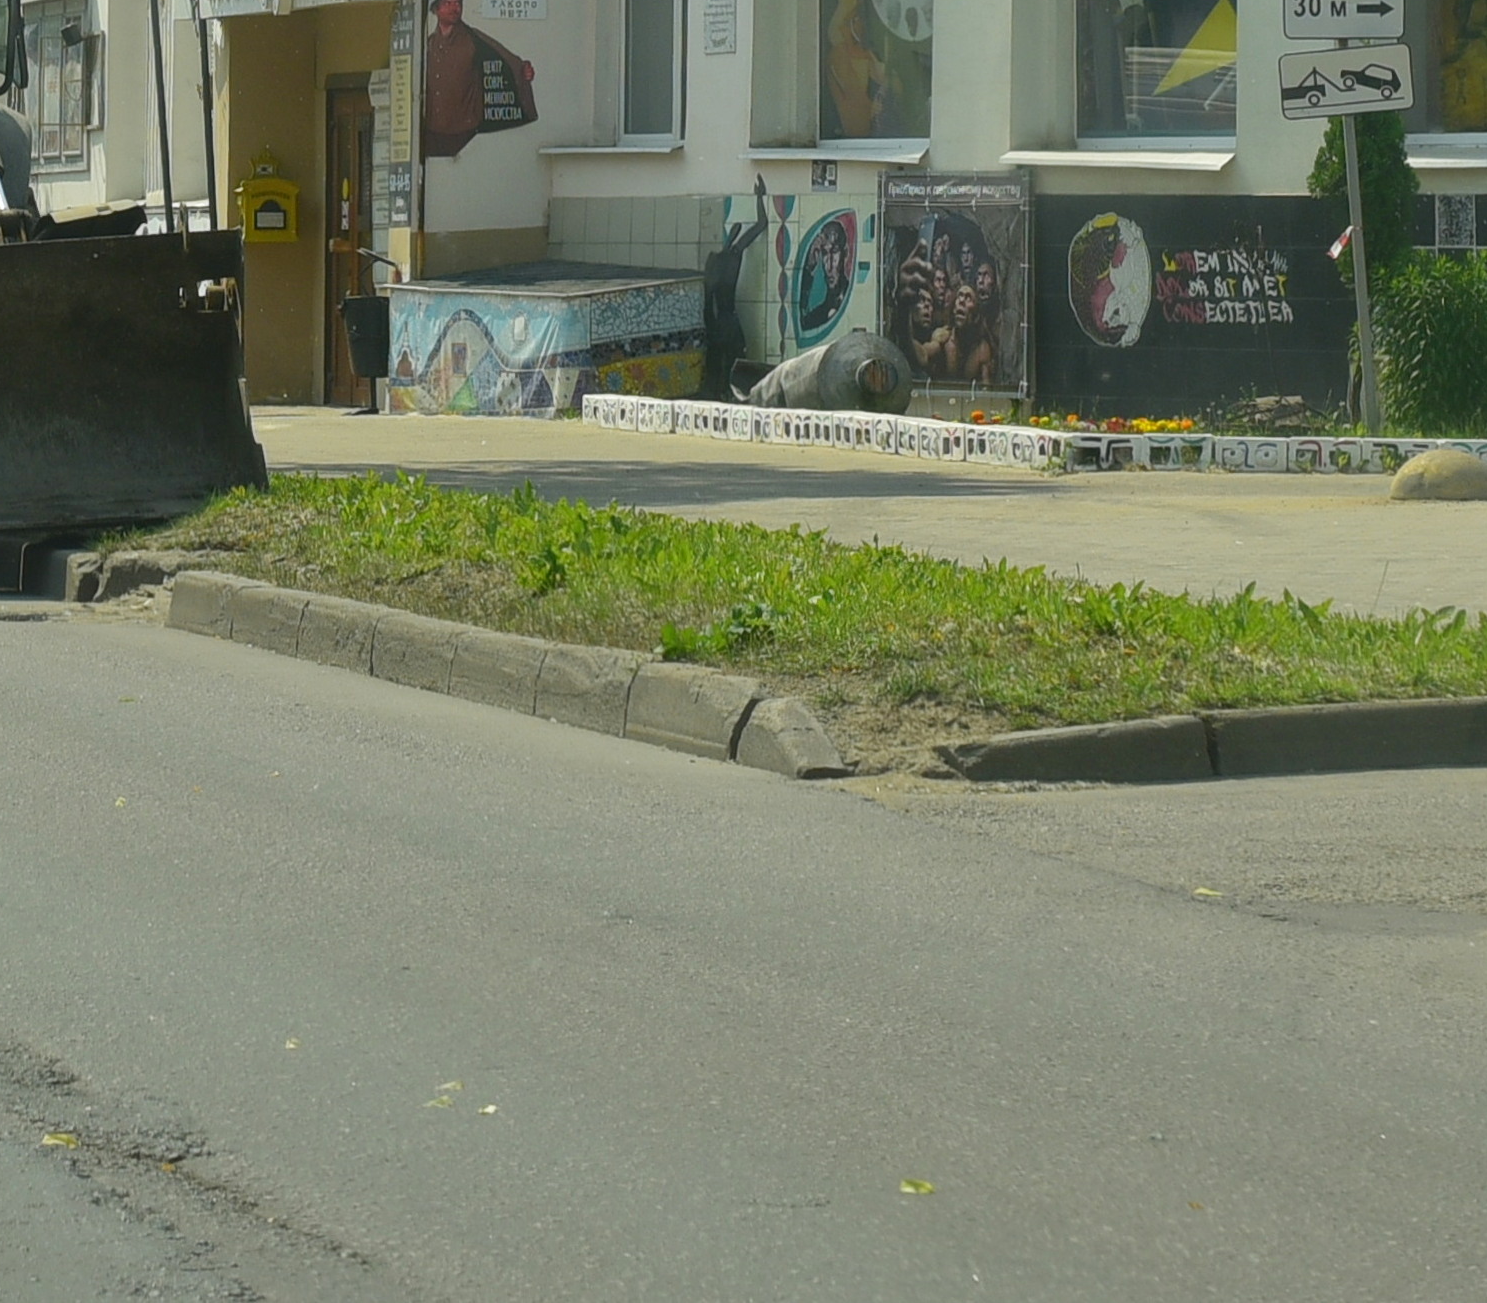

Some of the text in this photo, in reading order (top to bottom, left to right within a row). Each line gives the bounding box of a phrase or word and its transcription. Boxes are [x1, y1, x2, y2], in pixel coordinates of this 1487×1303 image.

[490, 0, 538, 9] ТАКОГО
[499, 9, 529, 19] НЕТ!
[483, 60, 503, 75] ЦЕНТР
[483, 76, 508, 90] СОВРЕ-
[483, 91, 515, 105] МЕННОГО
[484, 106, 523, 121] ИСКУССТВА
[982, 184, 1022, 199] искусству
